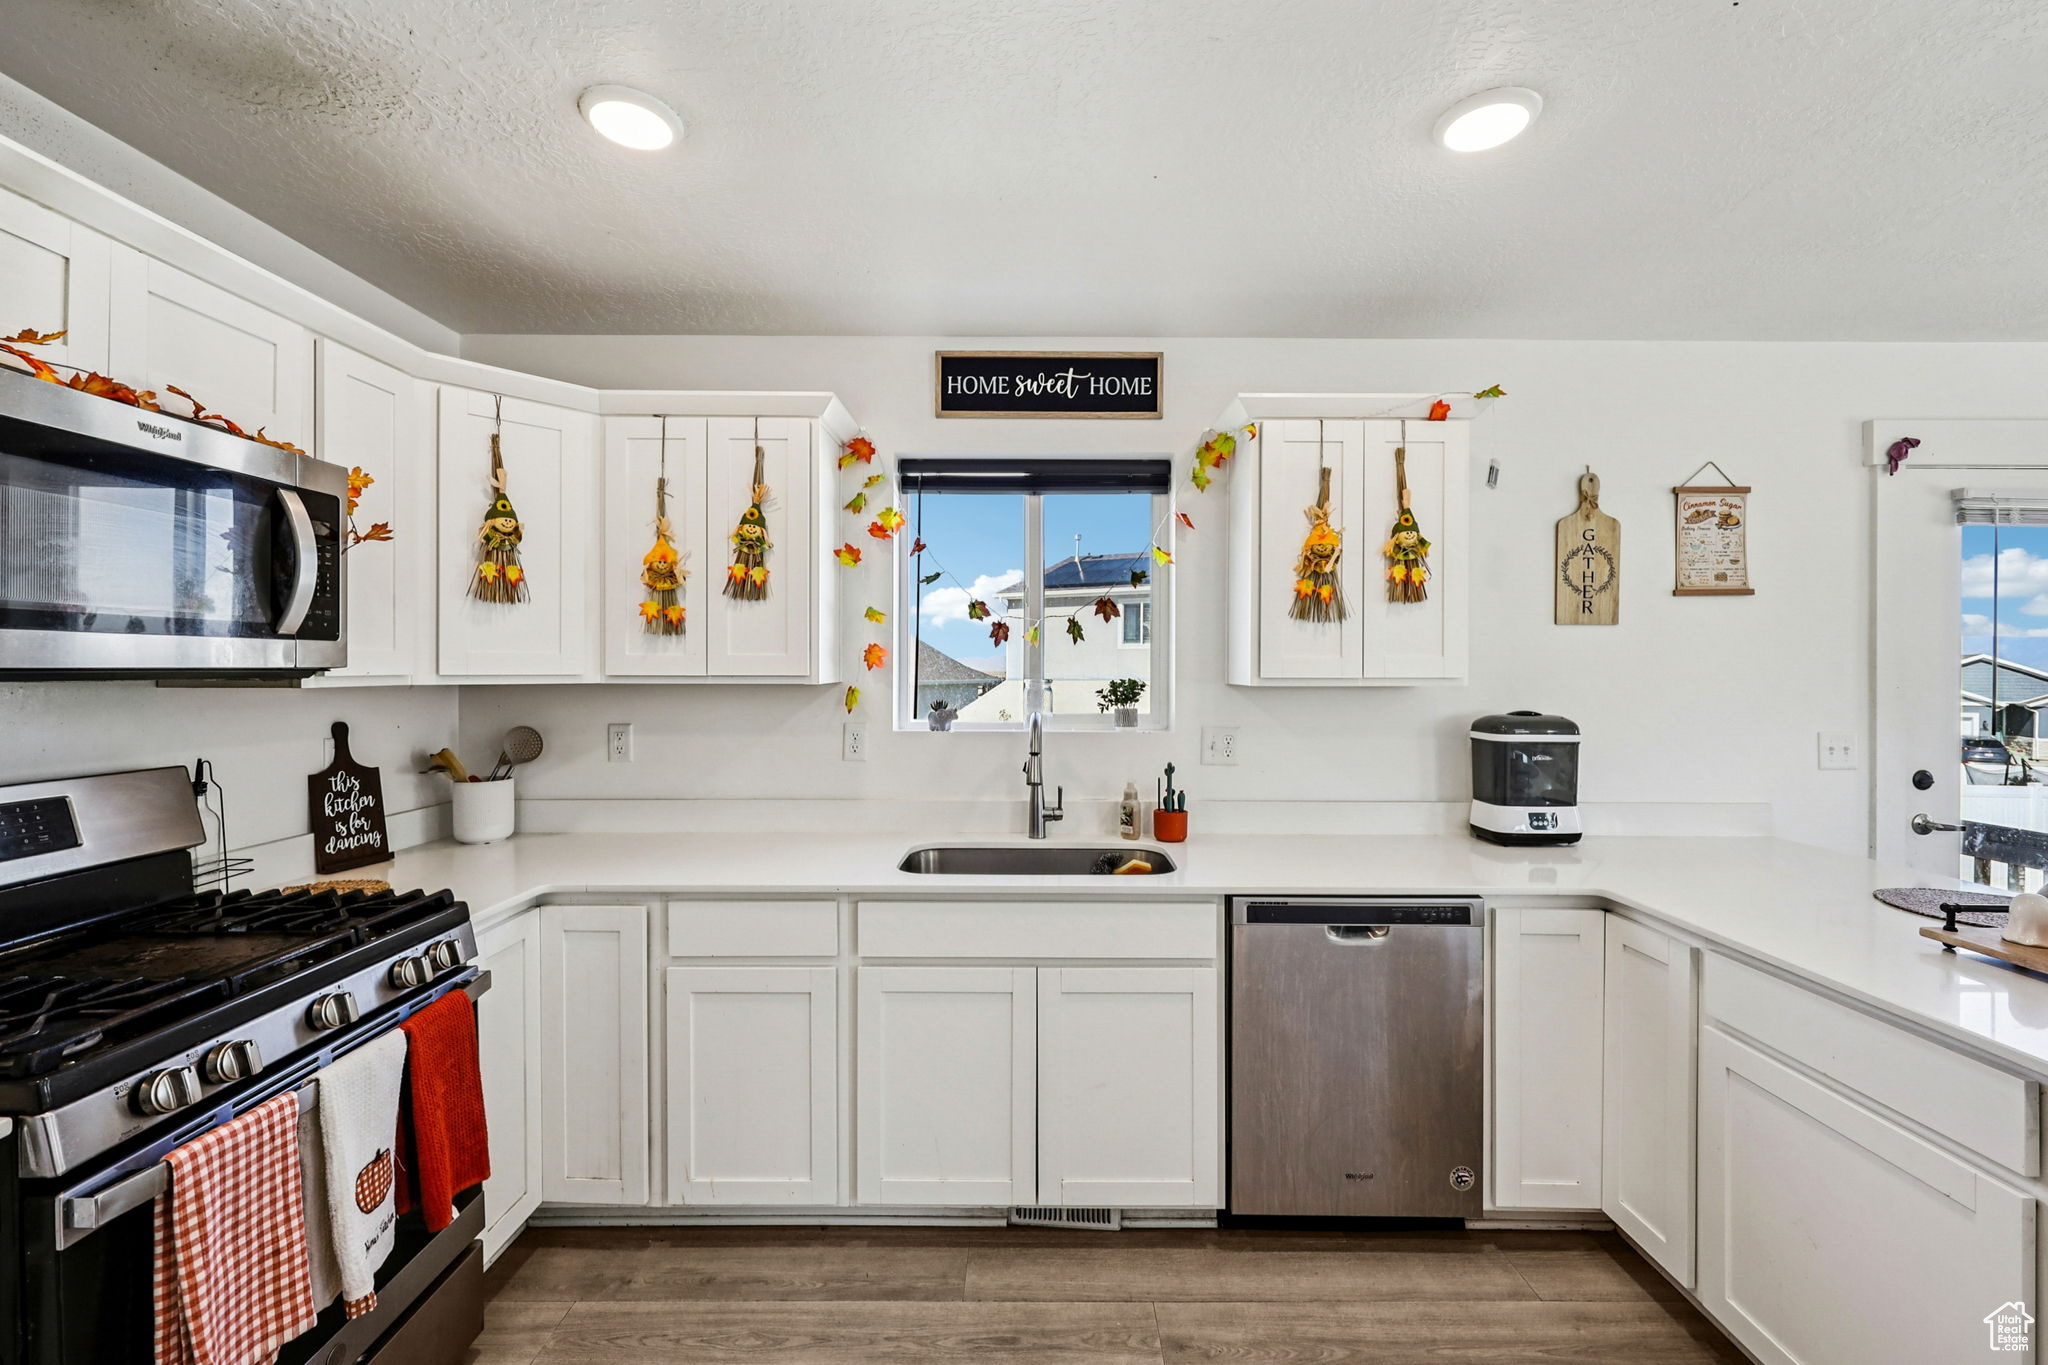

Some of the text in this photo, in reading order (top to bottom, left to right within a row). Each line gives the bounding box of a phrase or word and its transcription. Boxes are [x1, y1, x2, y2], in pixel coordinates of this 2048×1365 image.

[947, 367, 1152, 399] HOME sweet HOME
[137, 421, 182, 441] Whirlpool
[1683, 498, 1742, 511] Cinnamon Sugar
[1582, 528, 1595, 614] GATHER
[328, 770, 360, 793] this
[324, 790, 375, 817] kitchen
[335, 811, 371, 837] is for
[325, 830, 382, 855] dancing
